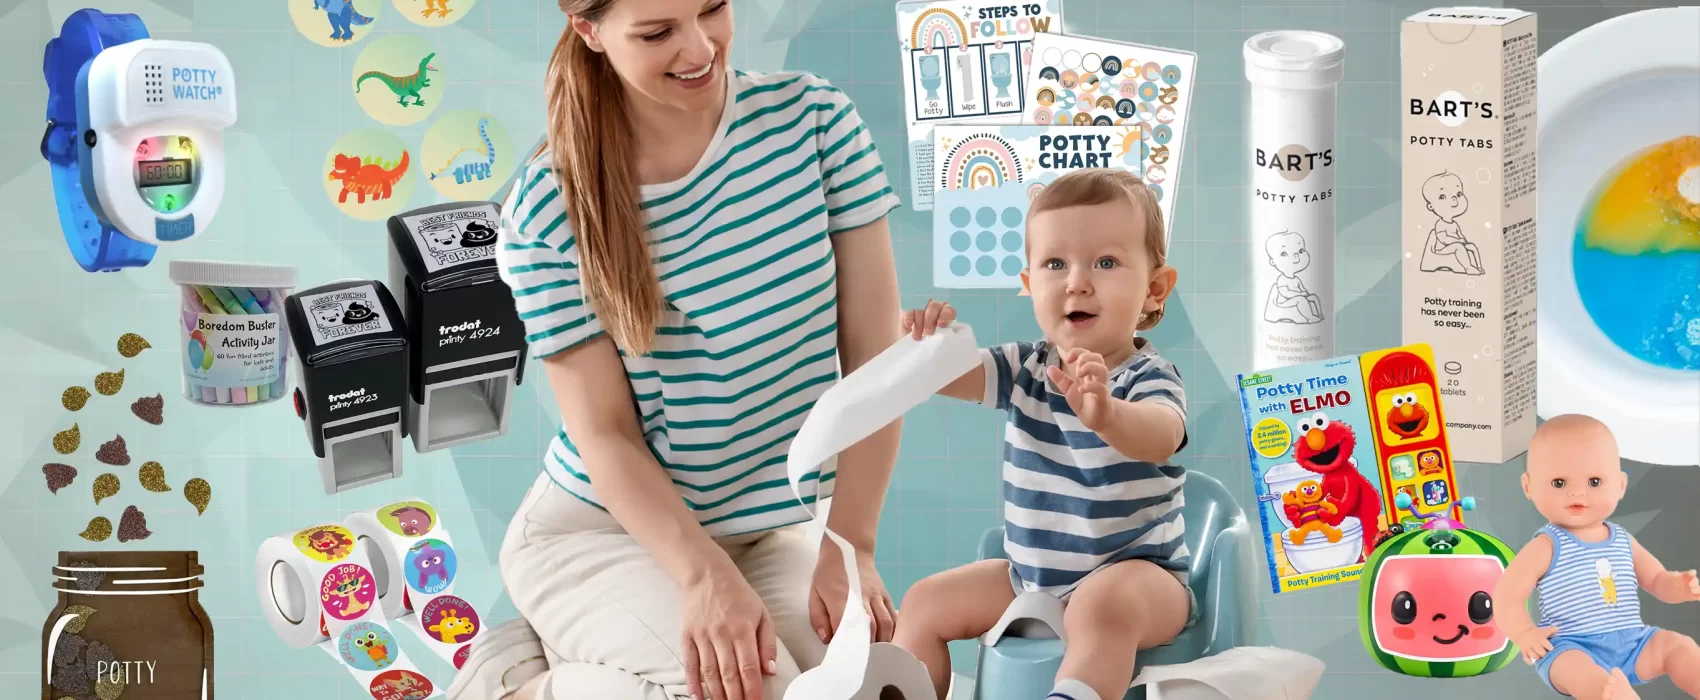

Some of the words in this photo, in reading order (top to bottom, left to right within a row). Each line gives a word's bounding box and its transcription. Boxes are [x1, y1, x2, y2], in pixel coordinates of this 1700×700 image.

[978, 5, 1018, 19] STEPS
[1022, 4, 1041, 16] TO
[970, 16, 1051, 38] FOLLOW
[172, 67, 216, 82] POTTY
[962, 103, 976, 112] Wipe
[1410, 98, 1493, 119] BART'S
[1040, 134, 1111, 151] POTTY
[1410, 136, 1454, 146] POTTY
[1460, 138, 1493, 149] TABS
[1038, 152, 1112, 169] CHART
[1256, 148, 1332, 171] BART'S
[147, 165, 182, 180] 60:00
[1256, 188, 1296, 204] POTTY
[1304, 188, 1332, 203] TABS
[420, 214, 445, 226] BEST
[446, 211, 487, 220] FRIENDS
[158, 221, 191, 236] TIMER
[434, 244, 497, 266] FOREVE
[334, 292, 366, 300] FRIENDS
[1424, 297, 1447, 308] Potty
[1448, 298, 1482, 309] training
[1420, 308, 1436, 316] has
[1463, 310, 1485, 318] been
[198, 319, 244, 331] Boredom
[248, 320, 276, 331] Buster
[320, 320, 381, 340] FOREVER
[439, 320, 482, 336] trodat
[222, 336, 260, 350] Activity
[262, 336, 276, 346] Jar
[440, 334, 466, 347] printy
[469, 326, 500, 340] 4924
[1256, 382, 1303, 398] Potty
[1306, 374, 1348, 390] Time
[1440, 388, 1466, 396] tablets
[328, 388, 366, 402] trodat
[330, 400, 352, 412] printy
[353, 394, 378, 405] 4923
[1258, 402, 1286, 414] with
[1290, 390, 1351, 414] ELMO
[322, 574, 336, 602] GOOD
[338, 565, 361, 575] JOB!
[425, 578, 448, 594] WOW!
[1288, 579, 1309, 587] Potty
[1310, 573, 1340, 583] Training
[424, 602, 439, 623] WELL
[438, 598, 470, 610] DONE!
[97, 660, 156, 684] POTTY
